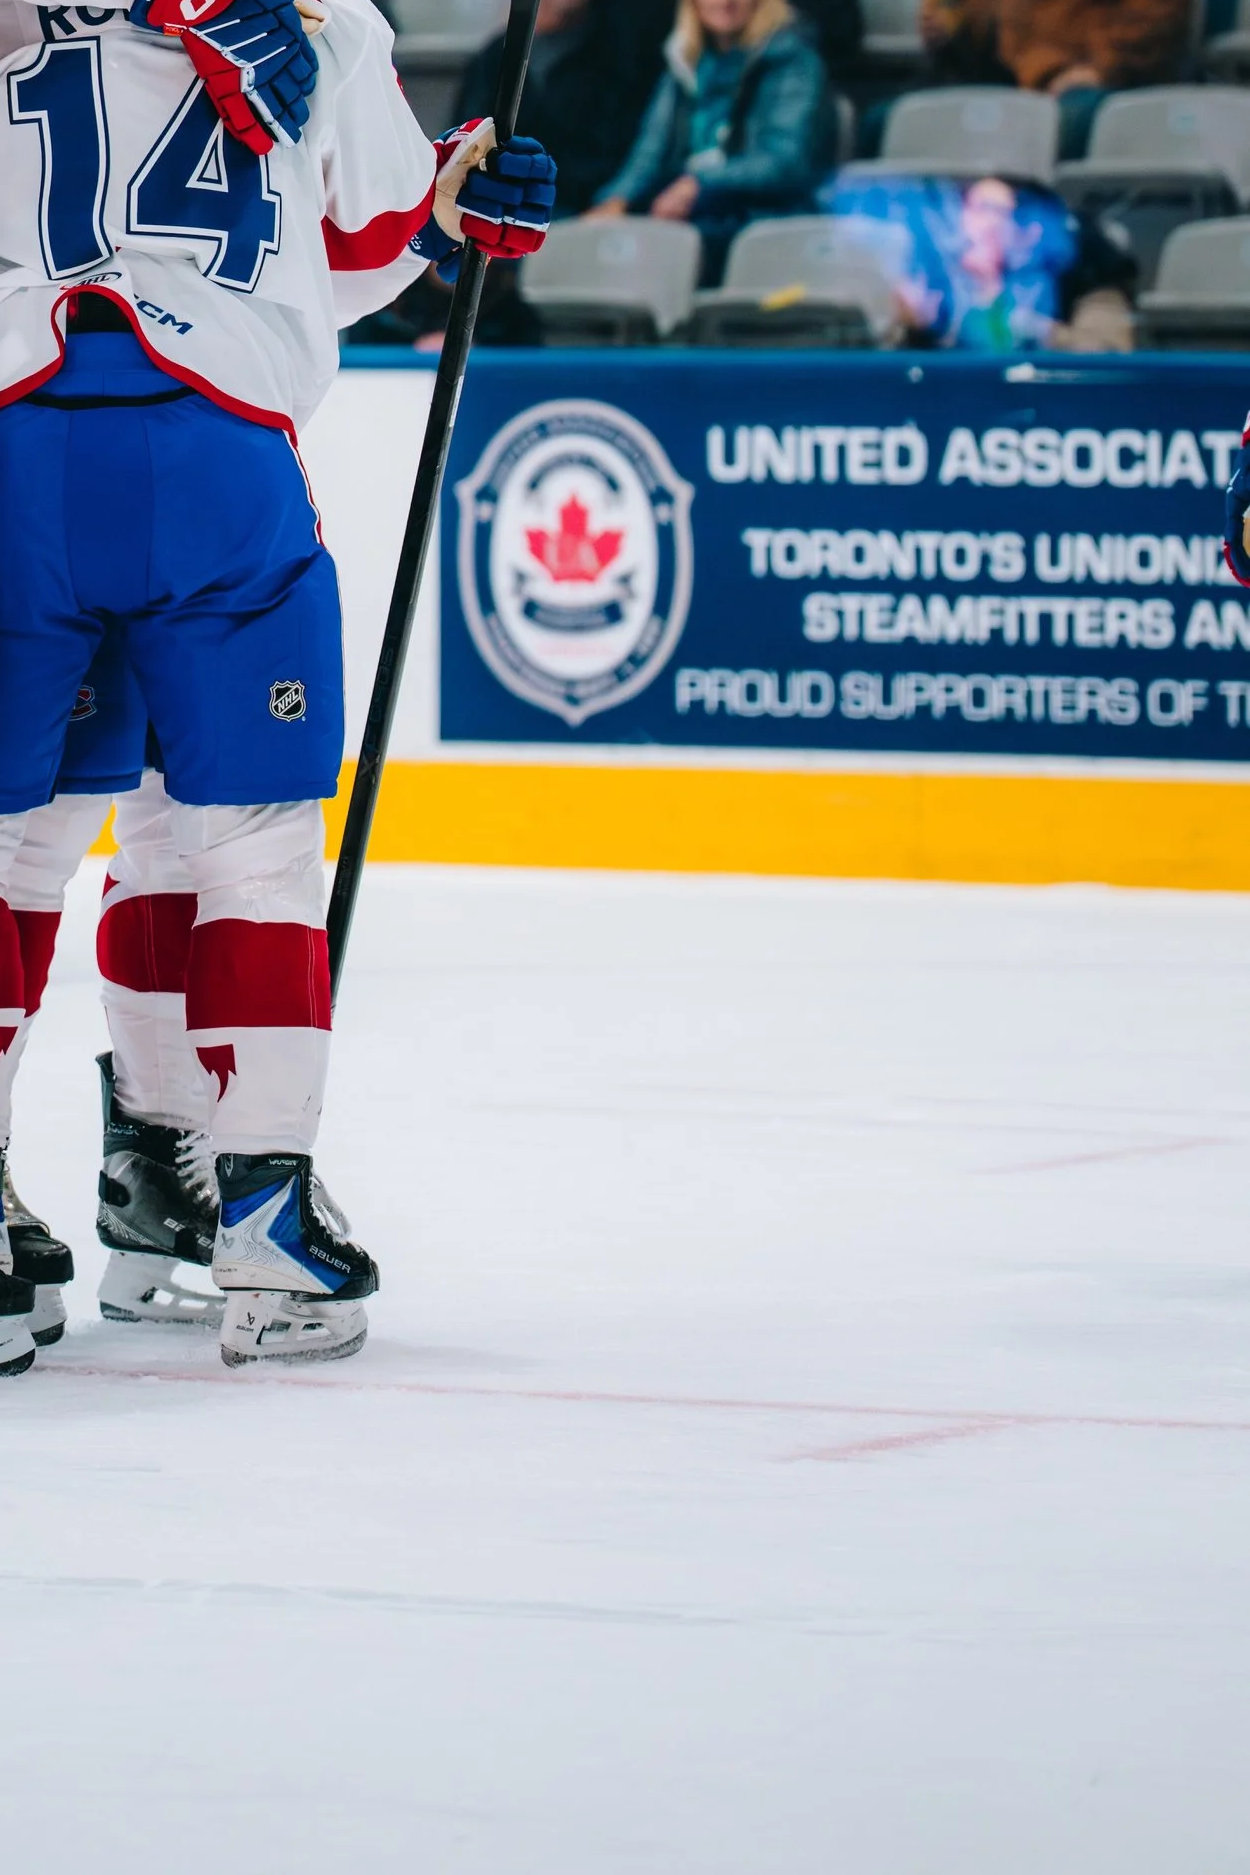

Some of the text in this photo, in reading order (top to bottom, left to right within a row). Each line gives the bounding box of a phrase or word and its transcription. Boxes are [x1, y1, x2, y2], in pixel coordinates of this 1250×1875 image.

[6, 35, 283, 294] 14
[133, 293, 194, 336] CM
[705, 423, 929, 486] UNITED
[938, 426, 1243, 489] ASSOCIAT
[740, 527, 1027, 583] TORONTO'S
[802, 591, 1176, 650] STEAMFITTERS
[277, 690, 299, 713] NHL
[674, 667, 1250, 729] PROUD SUPPORTERS OF T
[308, 1243, 351, 1274] BAUER
